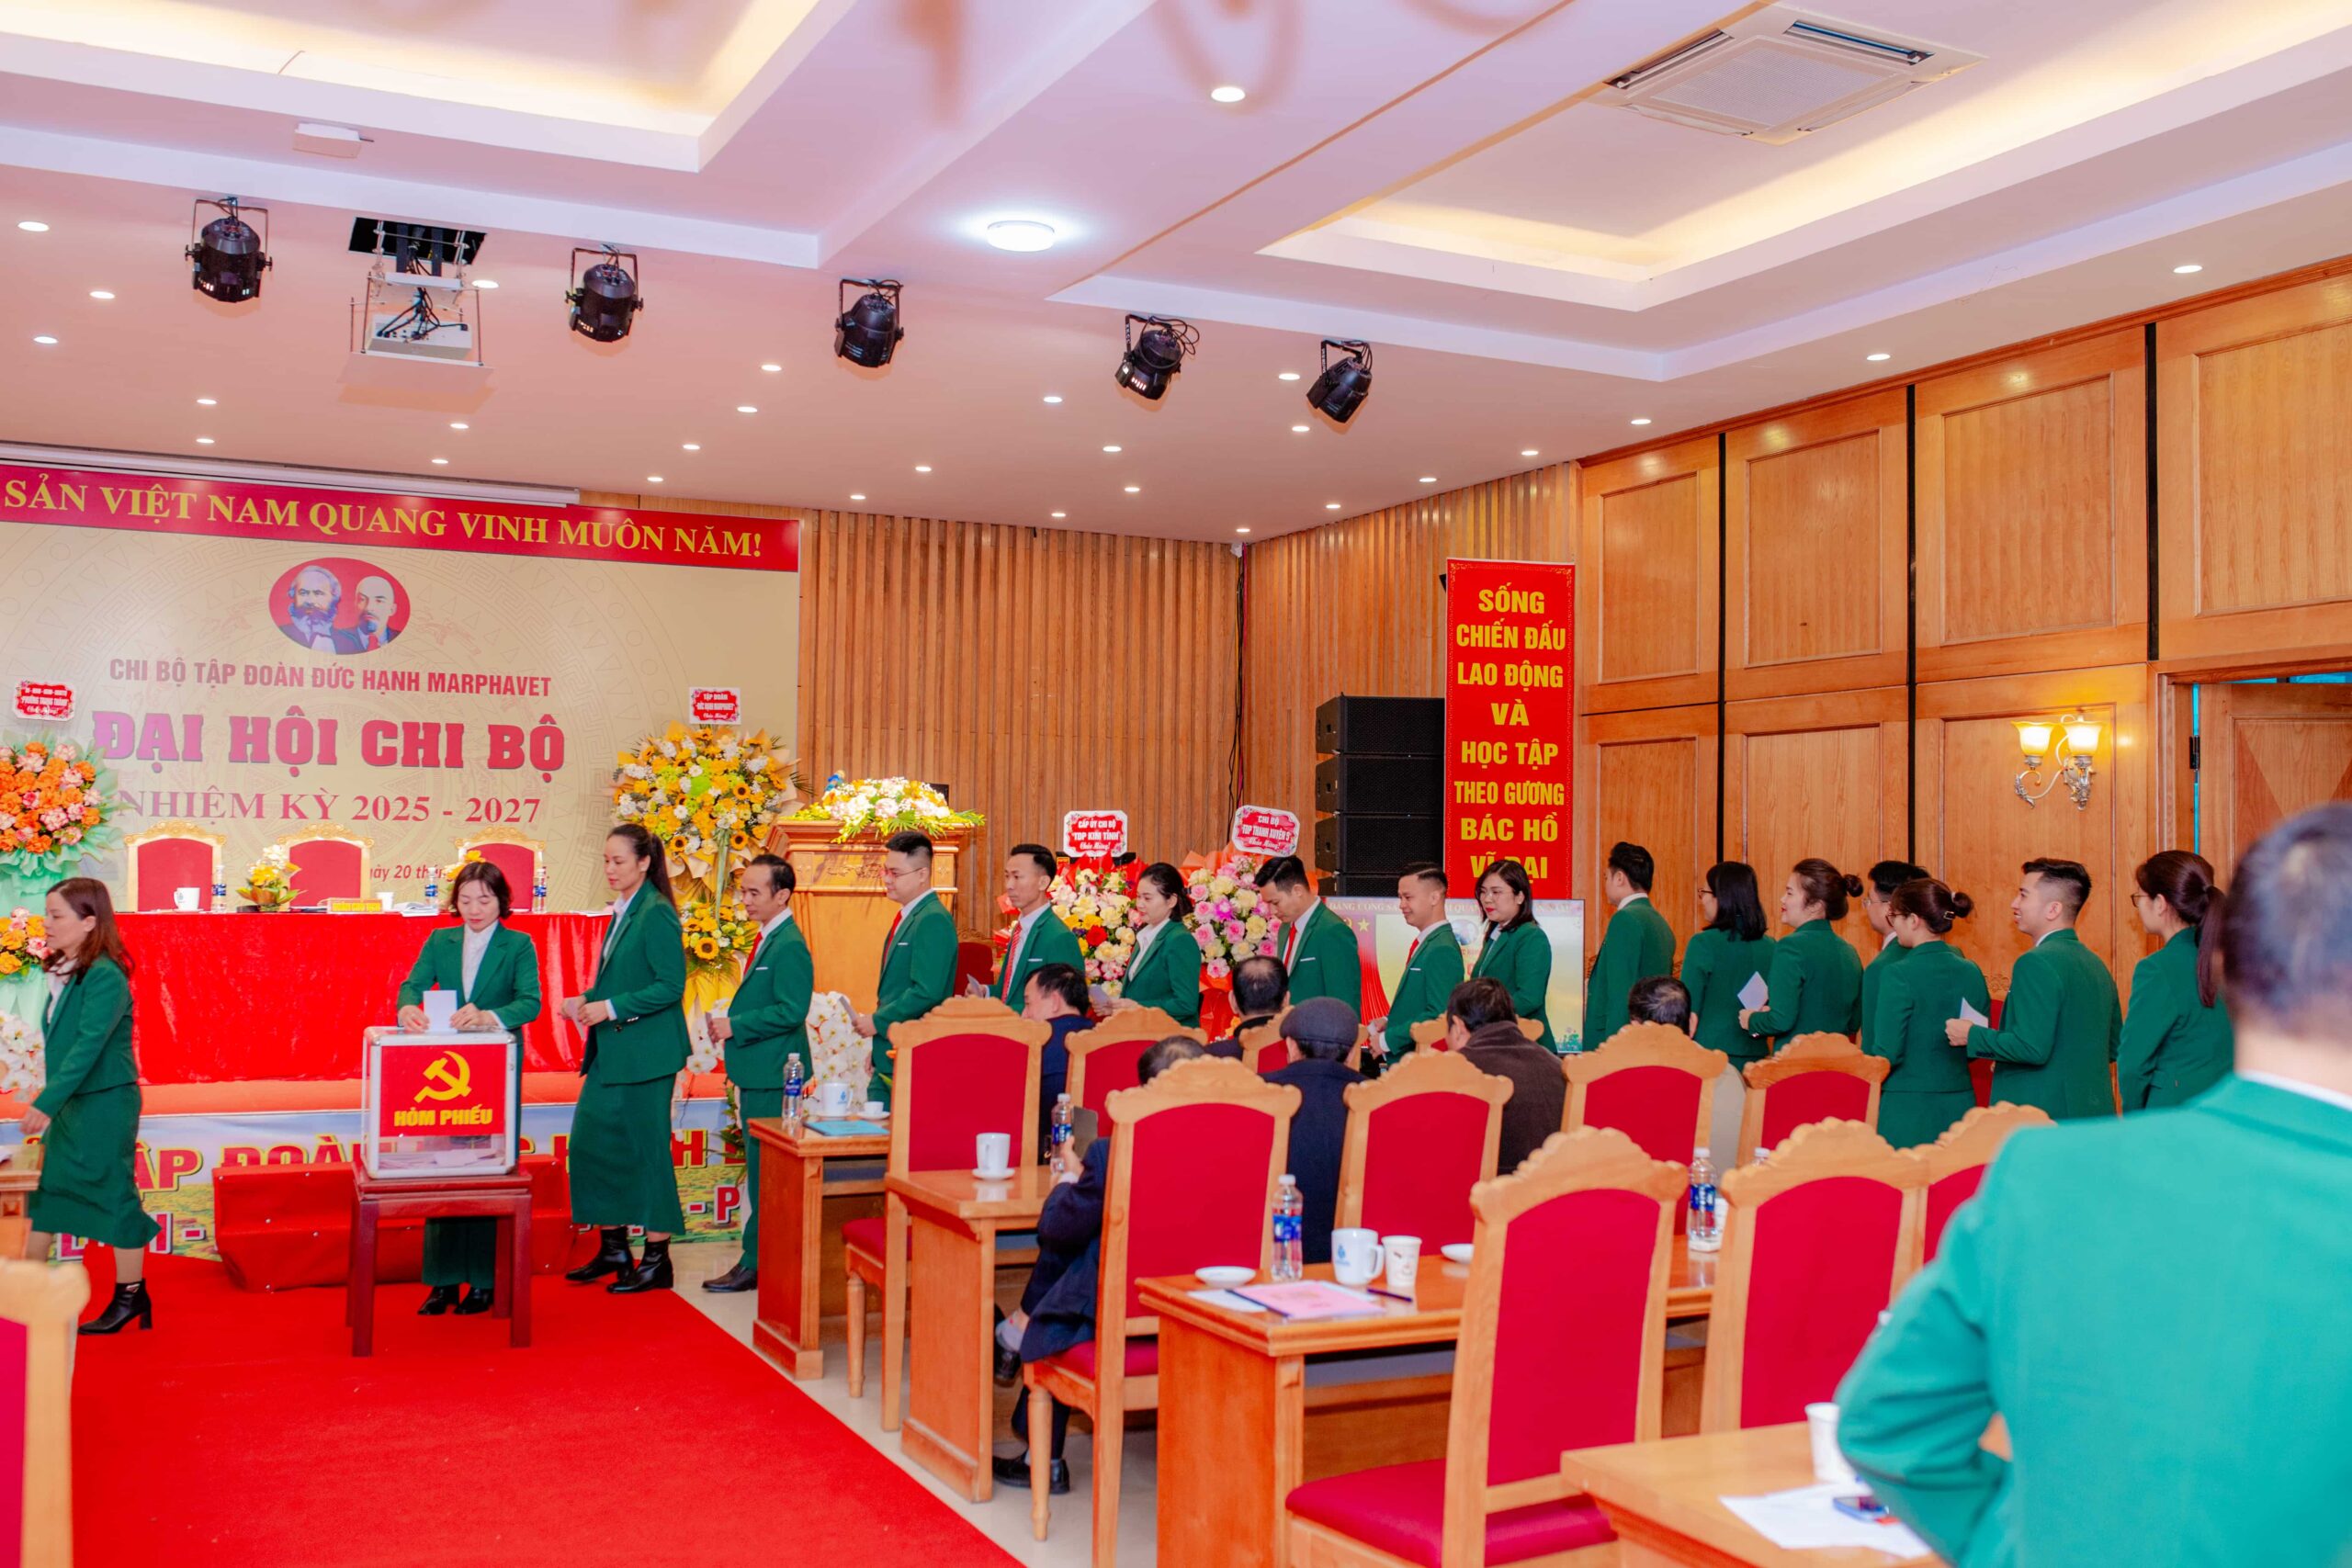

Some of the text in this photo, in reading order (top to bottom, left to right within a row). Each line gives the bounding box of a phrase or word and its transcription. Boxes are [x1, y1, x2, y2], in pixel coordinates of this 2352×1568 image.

[4, 472, 762, 558] SẢN VIỆT NAM QUANG VINH MUÔN NĂM!
[1478, 581, 1545, 615] SỐNG
[1455, 617, 1566, 651] CHIẾN ĐẤU
[109, 656, 552, 698] CHI BỘ TẬP ĐOÀN ĐỨC HẠNH MARPHAVET
[1457, 660, 1564, 692] LAO ĐỘNG
[1490, 698, 1530, 727] VÀ
[92, 705, 565, 783] ĐẠI HỘI CHI BỘ
[1461, 739, 1559, 770] HỌC TẬP
[119, 784, 266, 825] NHIỆM
[279, 786, 341, 820] KỲ
[351, 795, 431, 823] 2025
[464, 796, 540, 824] 2027
[1453, 780, 1565, 806] THEO GƯƠNG
[1460, 811, 1559, 842] BÁC HỒ
[393, 864, 412, 879] 20
[439, 1103, 493, 1126] PHIẾU
